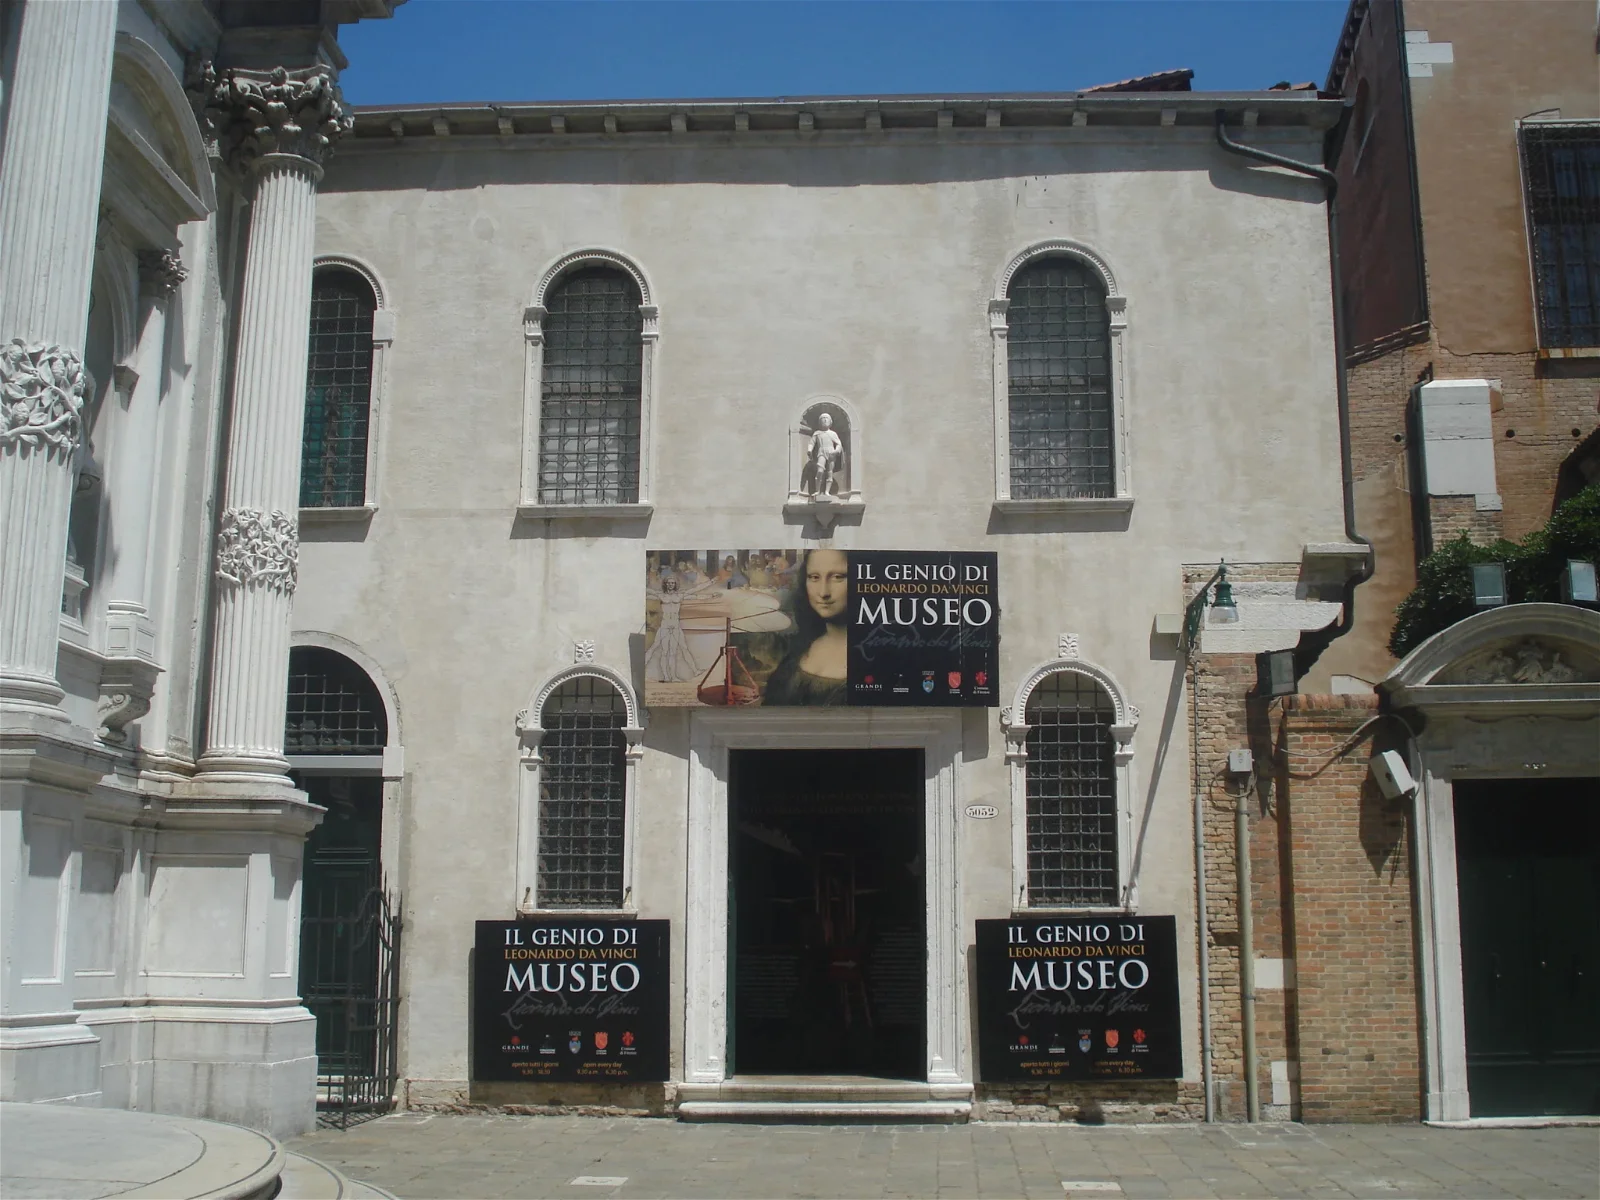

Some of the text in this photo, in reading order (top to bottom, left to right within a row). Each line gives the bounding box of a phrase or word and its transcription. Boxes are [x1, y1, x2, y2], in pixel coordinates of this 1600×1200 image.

[857, 564, 989, 581] IL GENIO DI
[857, 583, 989, 595] LEONARDO DA VINCI
[856, 597, 992, 626] MUSEO
[504, 928, 637, 945] IL GENIO DI
[1008, 924, 1145, 943] IL GENIO DI
[504, 948, 637, 959] LEONARDO DA VINCI
[1008, 945, 1145, 958] LEONARDO DA VINCI
[503, 962, 641, 992] MUSEO
[1008, 959, 1150, 991] MUSEO
